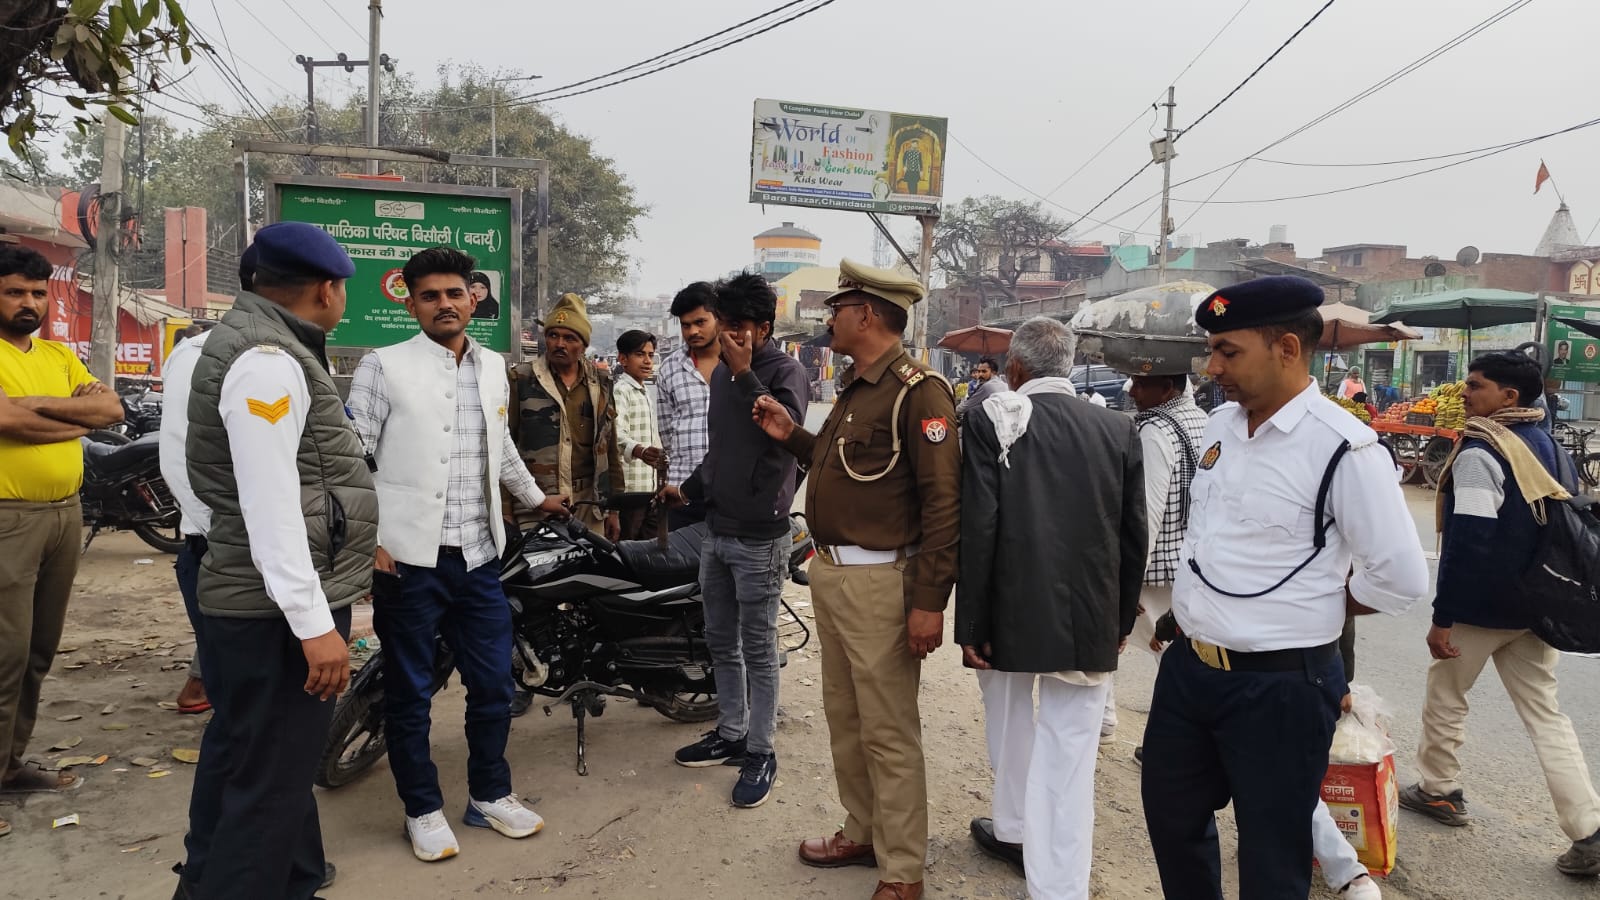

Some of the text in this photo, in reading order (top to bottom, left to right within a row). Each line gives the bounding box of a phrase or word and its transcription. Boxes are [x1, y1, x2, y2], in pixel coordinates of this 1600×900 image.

[762, 117, 842, 144] World
[822, 145, 873, 161] Fashion
[825, 164, 851, 174] Gents
[854, 165, 877, 176] Wear
[794, 175, 844, 187] Kids Wear
[762, 193, 787, 202] Bara
[326, 219, 370, 239] पालिका
[372, 222, 408, 241] परिषद
[411, 224, 452, 244] बिसौली
[1324, 785, 1354, 797] गगन
